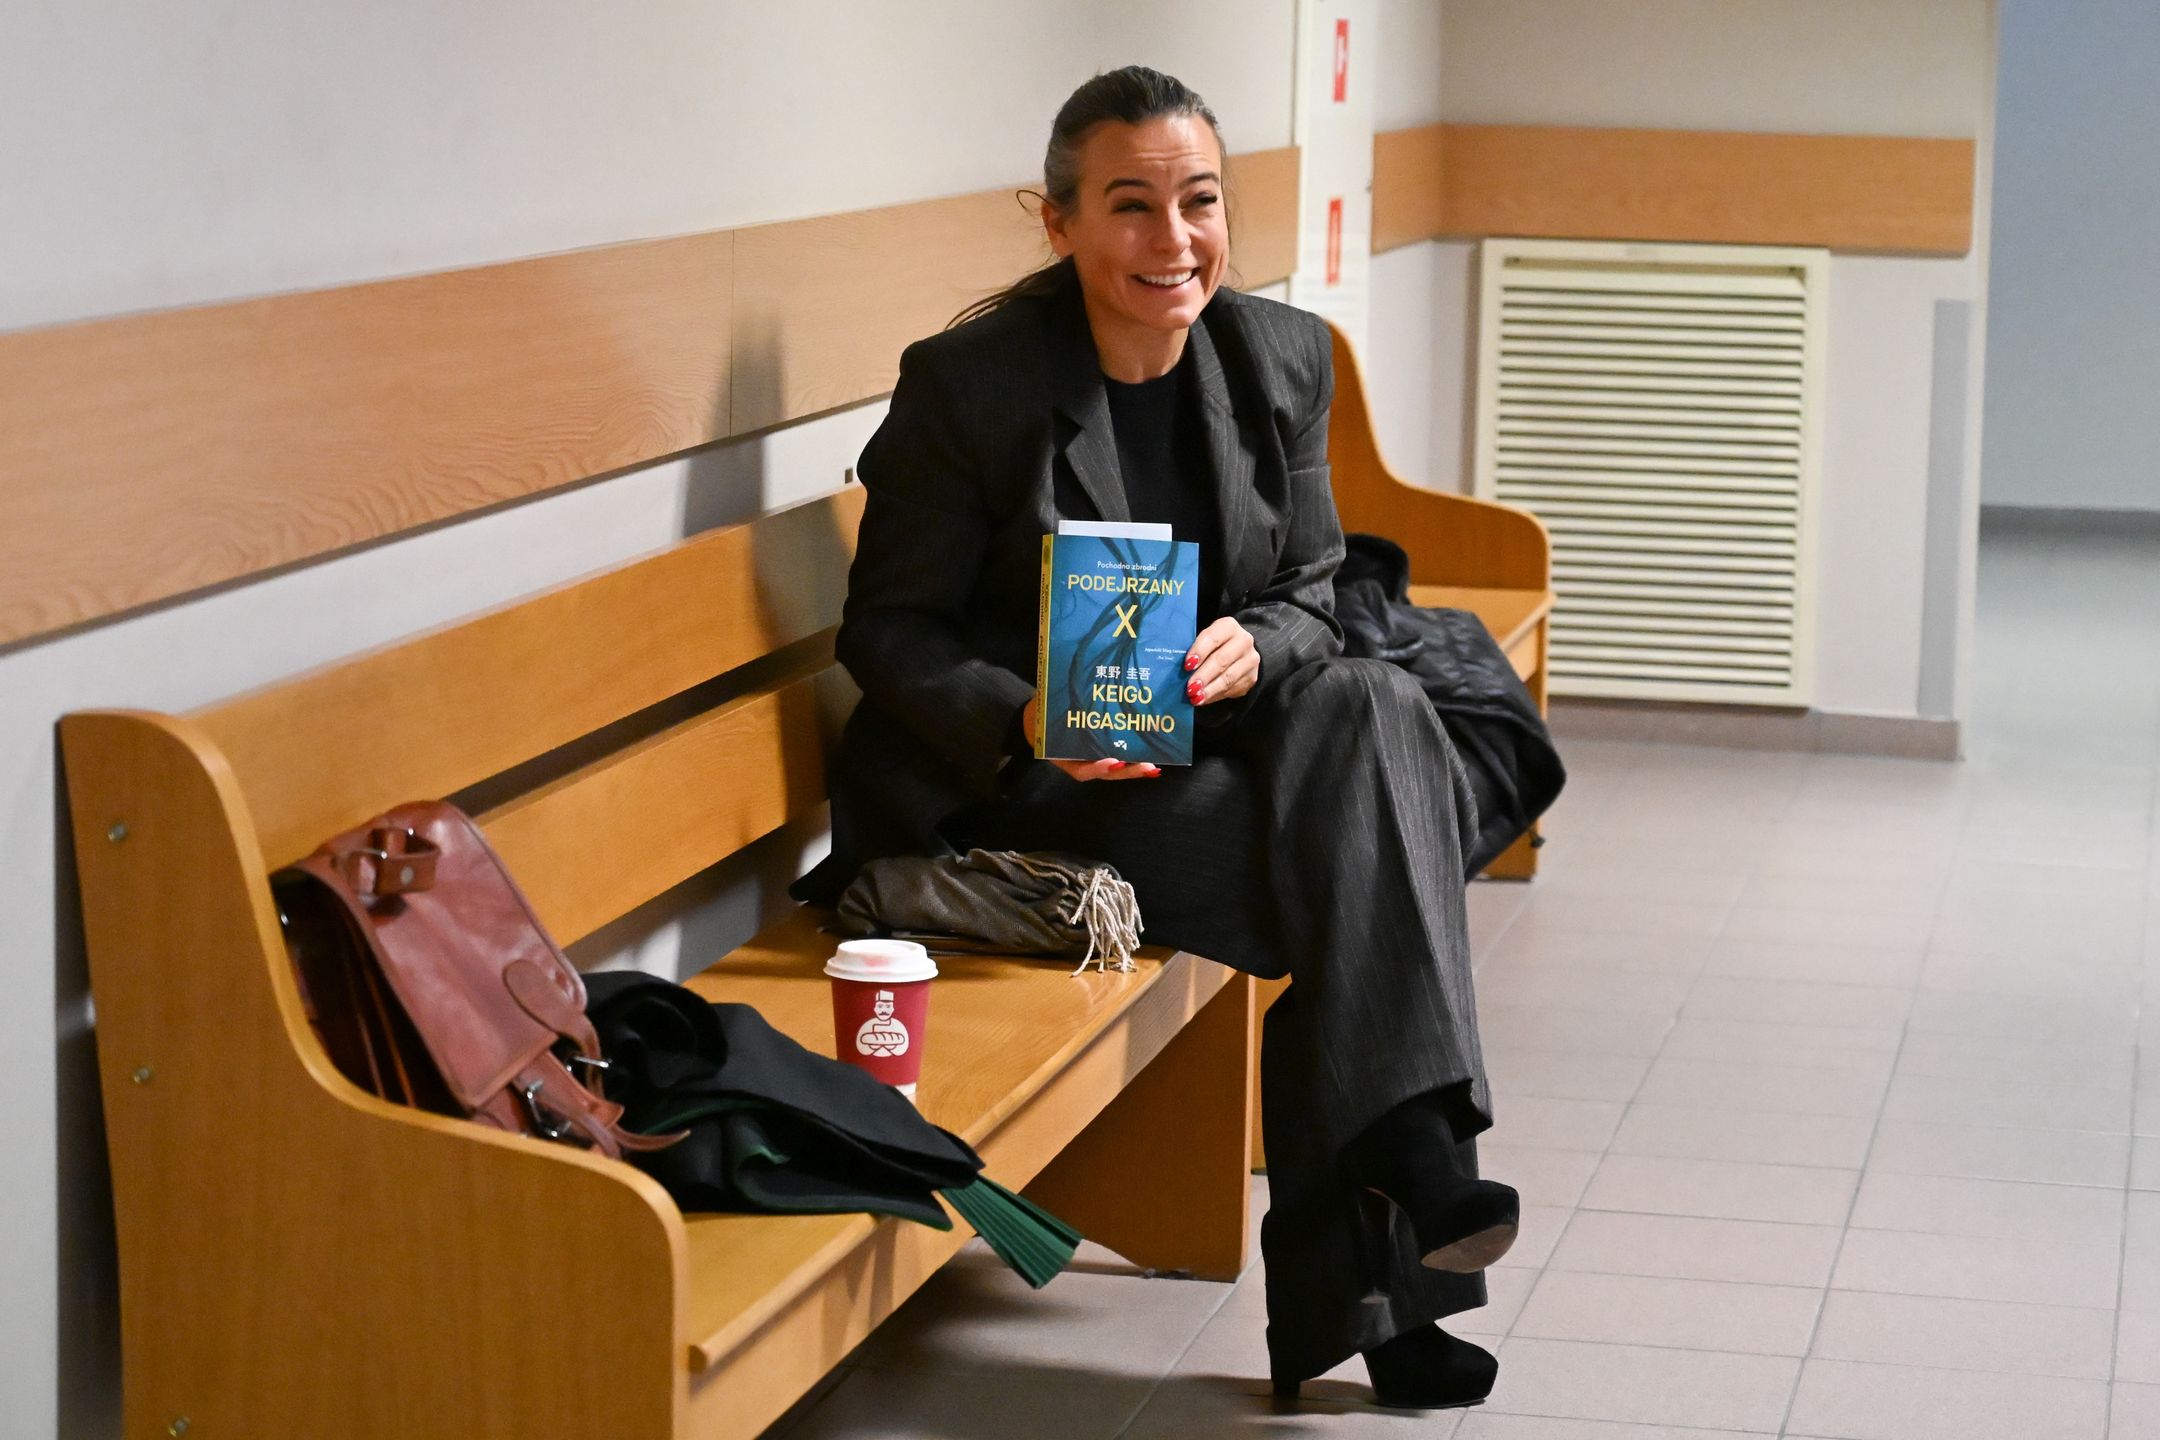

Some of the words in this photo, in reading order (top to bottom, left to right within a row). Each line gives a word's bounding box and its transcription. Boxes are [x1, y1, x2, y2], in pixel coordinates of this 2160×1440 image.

[1131, 563, 1158, 571] zbrodni
[1067, 574, 1185, 596] PODEJRZANY
[1112, 603, 1138, 639] X
[1095, 664, 1121, 680] 東野
[1126, 666, 1151, 681] 圭吾
[1092, 683, 1153, 705] KEIGO
[1066, 710, 1176, 734] HIGASHINO
